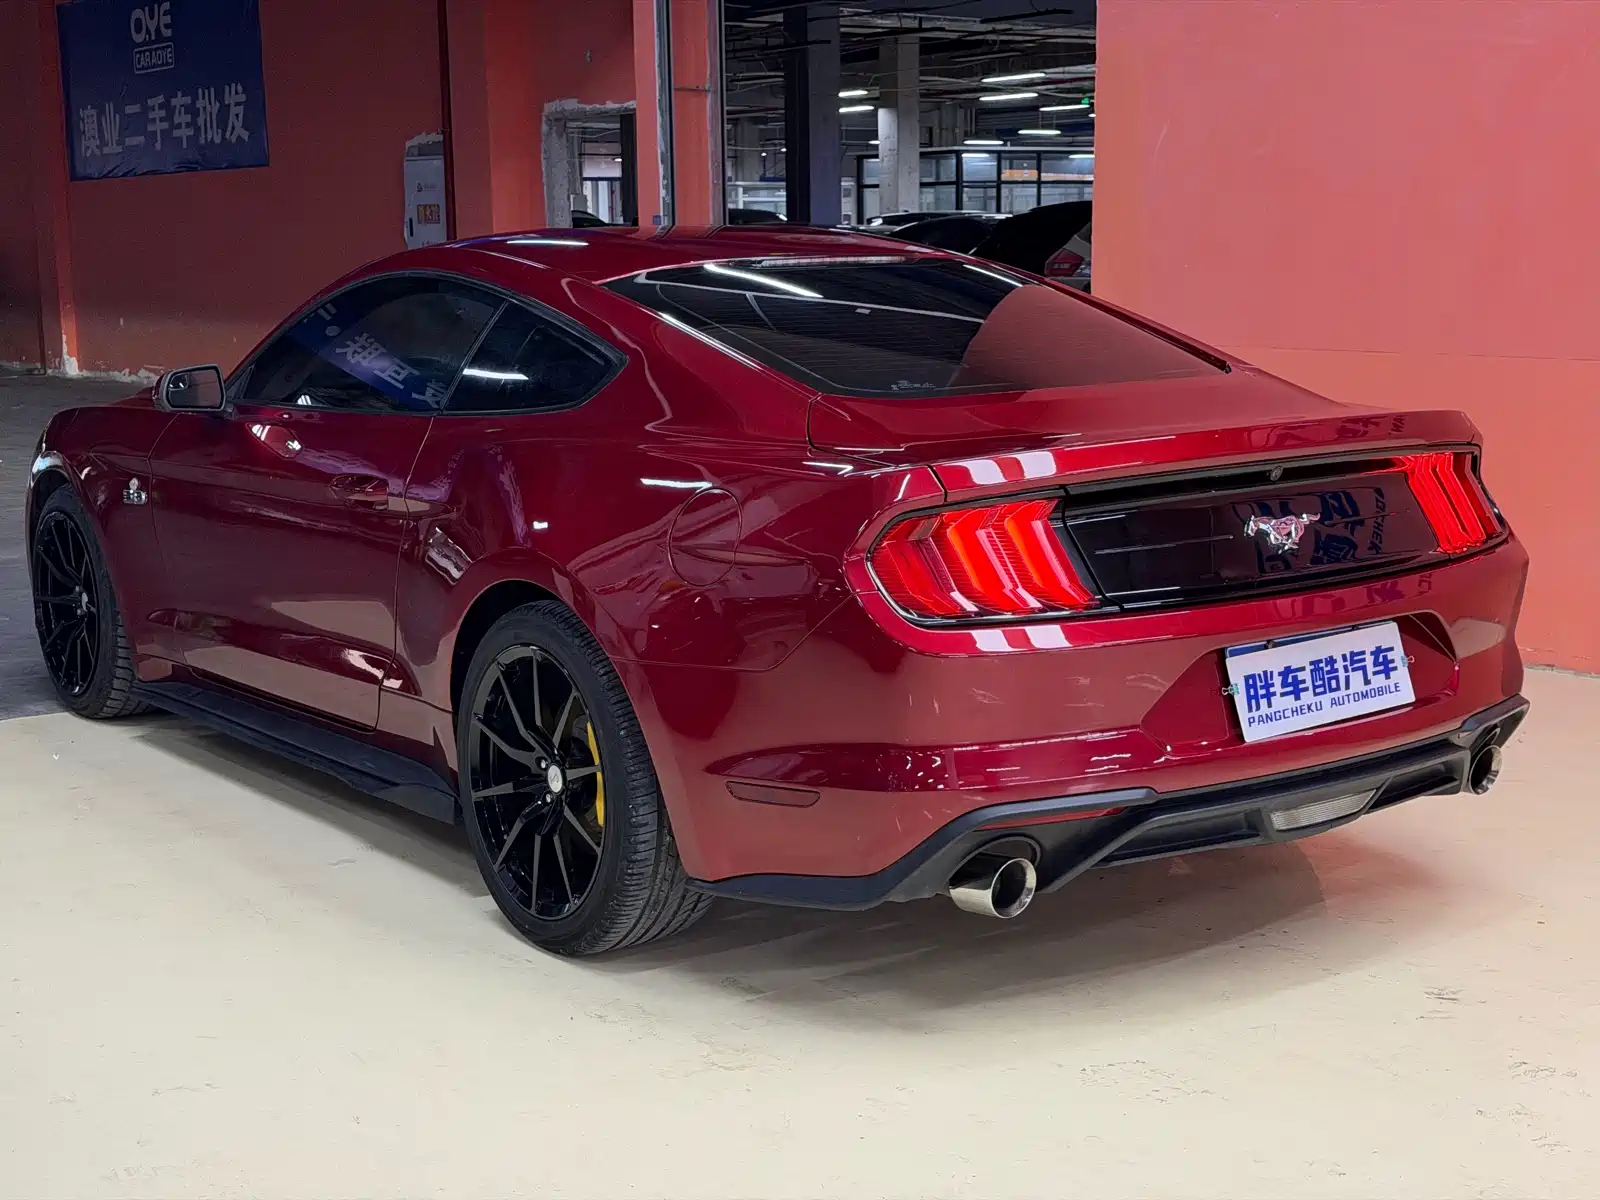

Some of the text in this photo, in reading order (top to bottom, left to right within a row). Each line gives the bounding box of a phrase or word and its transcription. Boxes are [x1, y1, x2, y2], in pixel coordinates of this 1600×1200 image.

[79, 82, 249, 157] 澳业二手车批发
[1243, 645, 1398, 713] 胖车酷汽车
[1247, 682, 1401, 728] PANGCHEKU AUTOMOBILE
